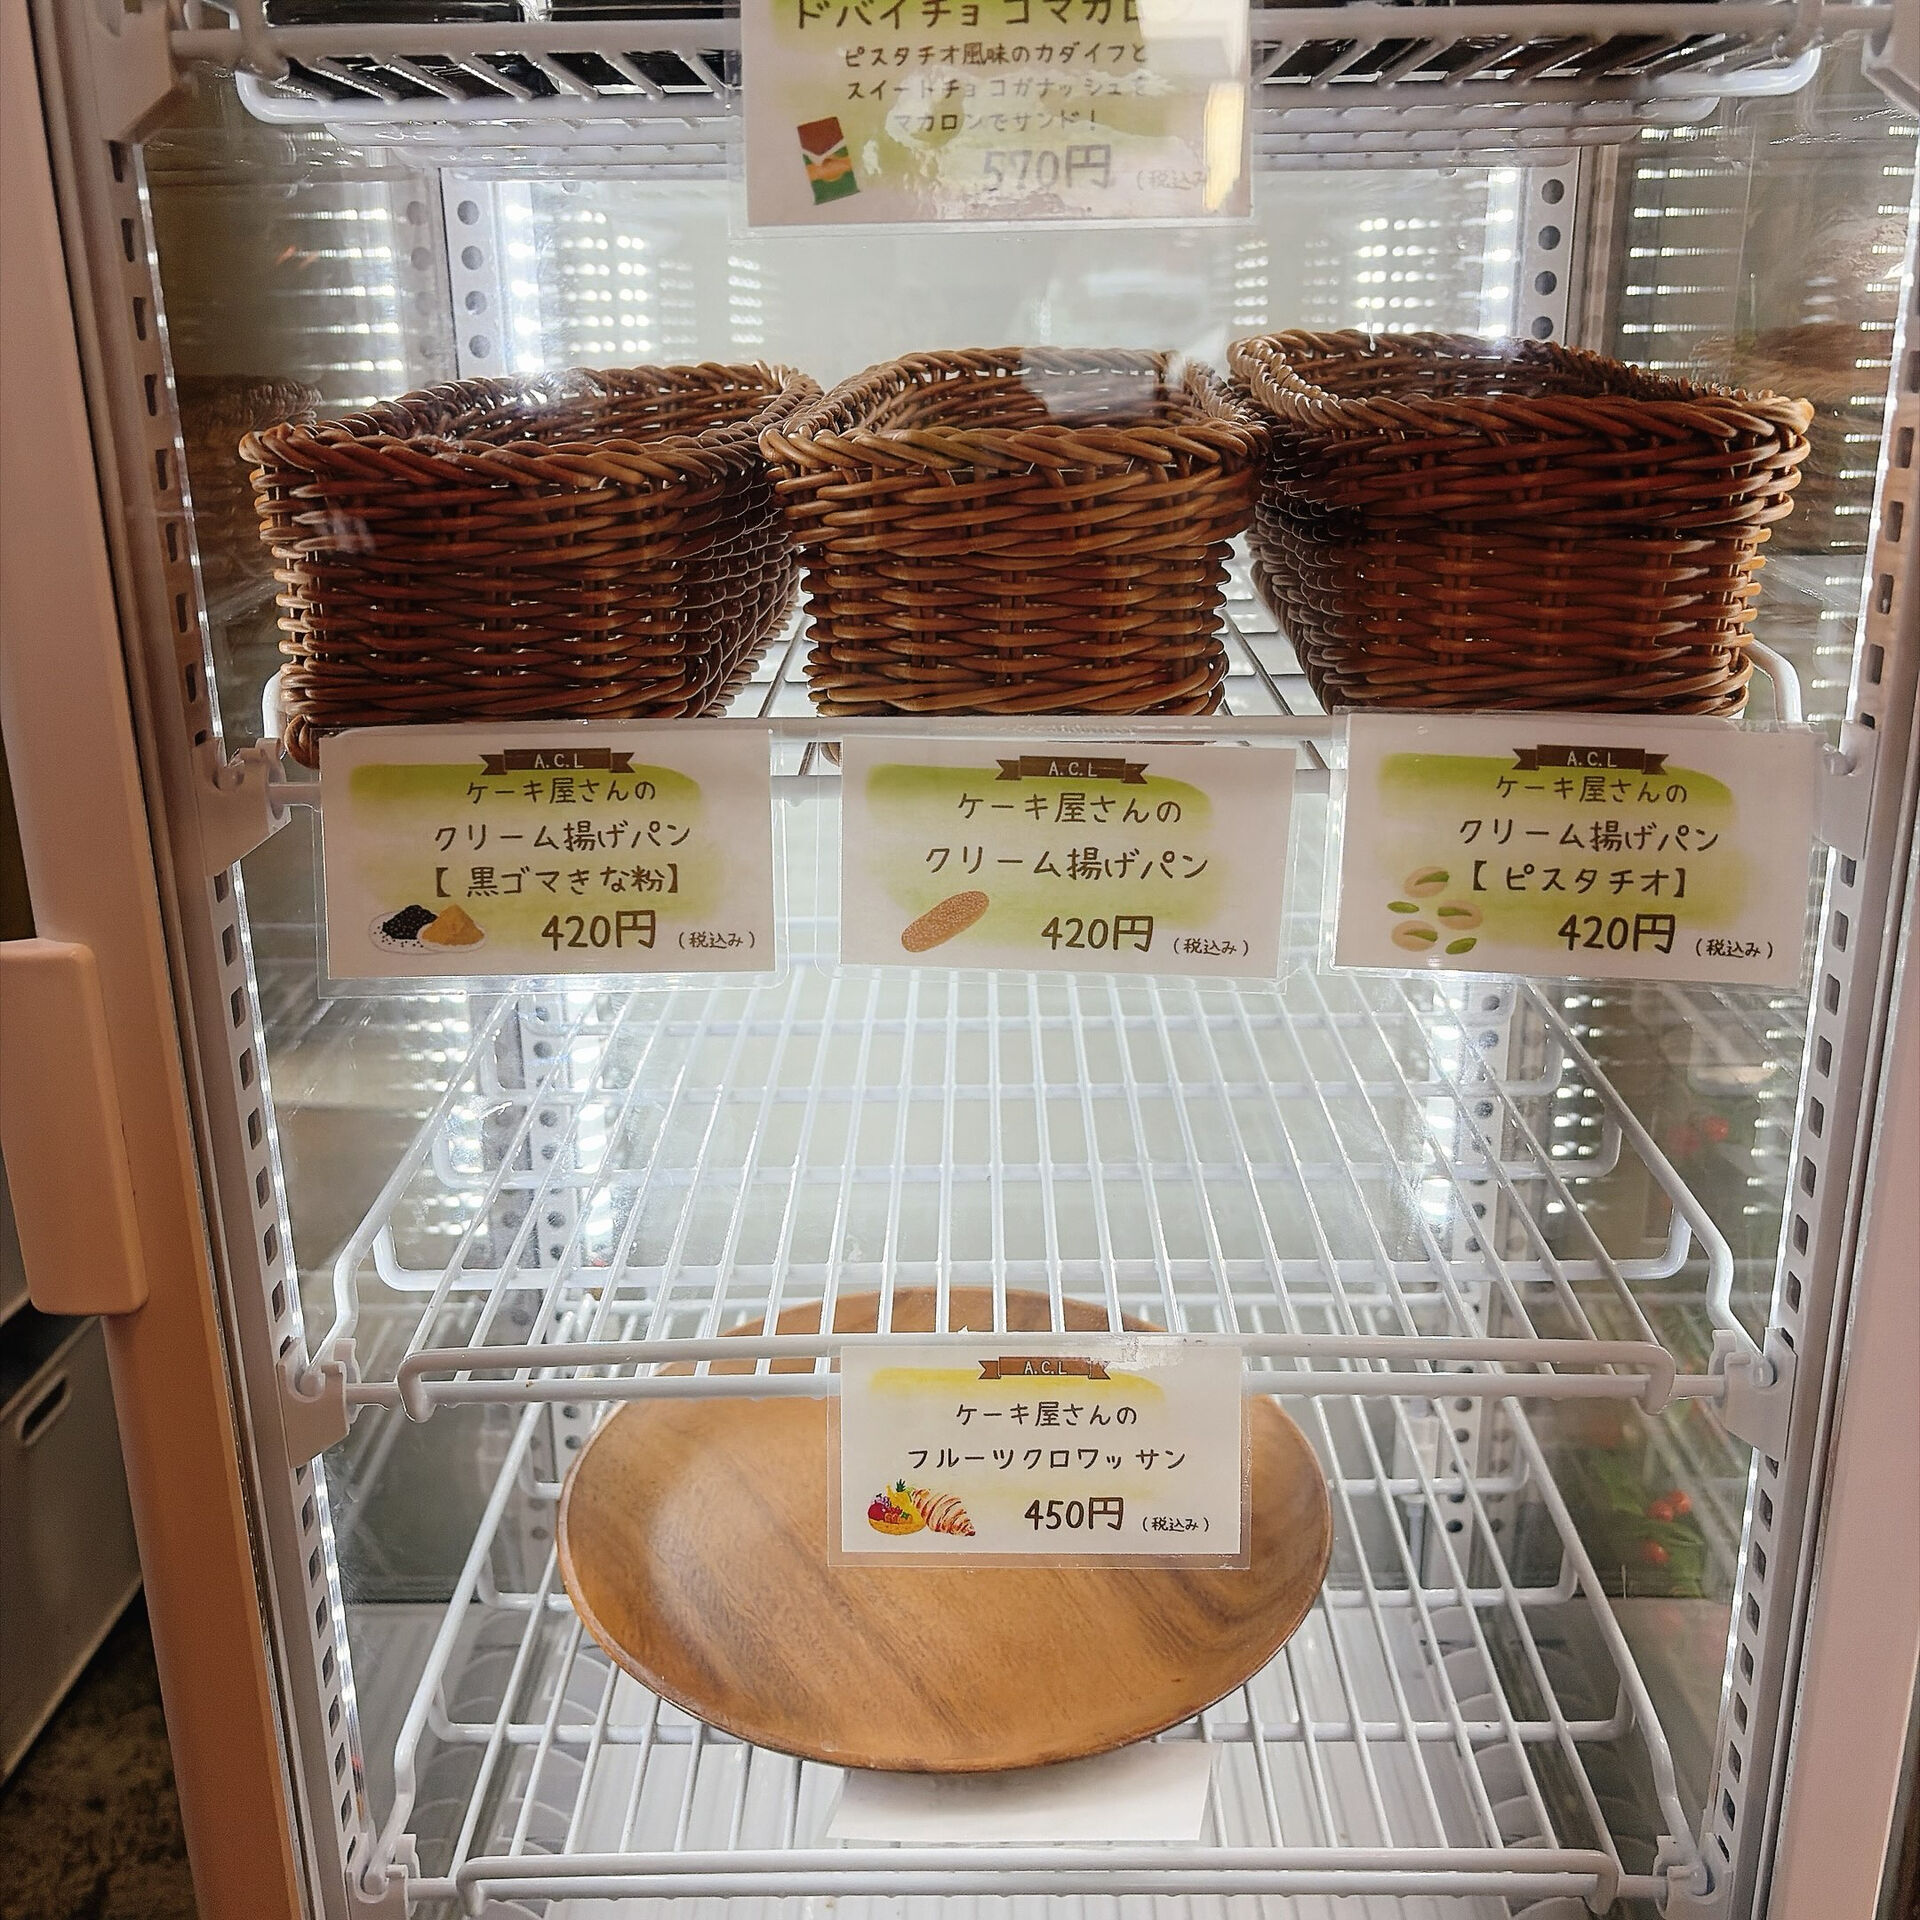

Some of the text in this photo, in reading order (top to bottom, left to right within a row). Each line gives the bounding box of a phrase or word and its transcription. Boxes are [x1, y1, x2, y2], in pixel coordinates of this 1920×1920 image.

[845, 41, 1147, 68] ピスタチオ風味のカダイフと
[893, 108, 1099, 133] マカロンでサンド!
[982, 144, 1111, 189] 570円
[534, 753, 585, 769] A.C.L
[1048, 761, 1098, 777] A.C.L
[1567, 751, 1618, 768] A.C.L
[466, 777, 656, 804] ケーキ屋さんの
[1495, 775, 1687, 804] ケーキ屋さんの
[957, 792, 1181, 823] ケーキ屋さんの
[434, 820, 691, 852] クリーム揚げパン
[1459, 818, 1719, 853] クリーム揚げパン
[925, 846, 1208, 881] クリーム揚げパン
[541, 909, 756, 951] 420円 (税込み)
[1041, 915, 1250, 956] 420円 (税込み)
[1557, 913, 1774, 959] 420円 (税込み)
[1024, 1360, 1068, 1375] A.C.L
[956, 1401, 1138, 1427] ケーキ屋さんの
[907, 1447, 1186, 1470] フルーツクロワッサン
[1024, 1497, 1210, 1533] 450円 (税込み)
